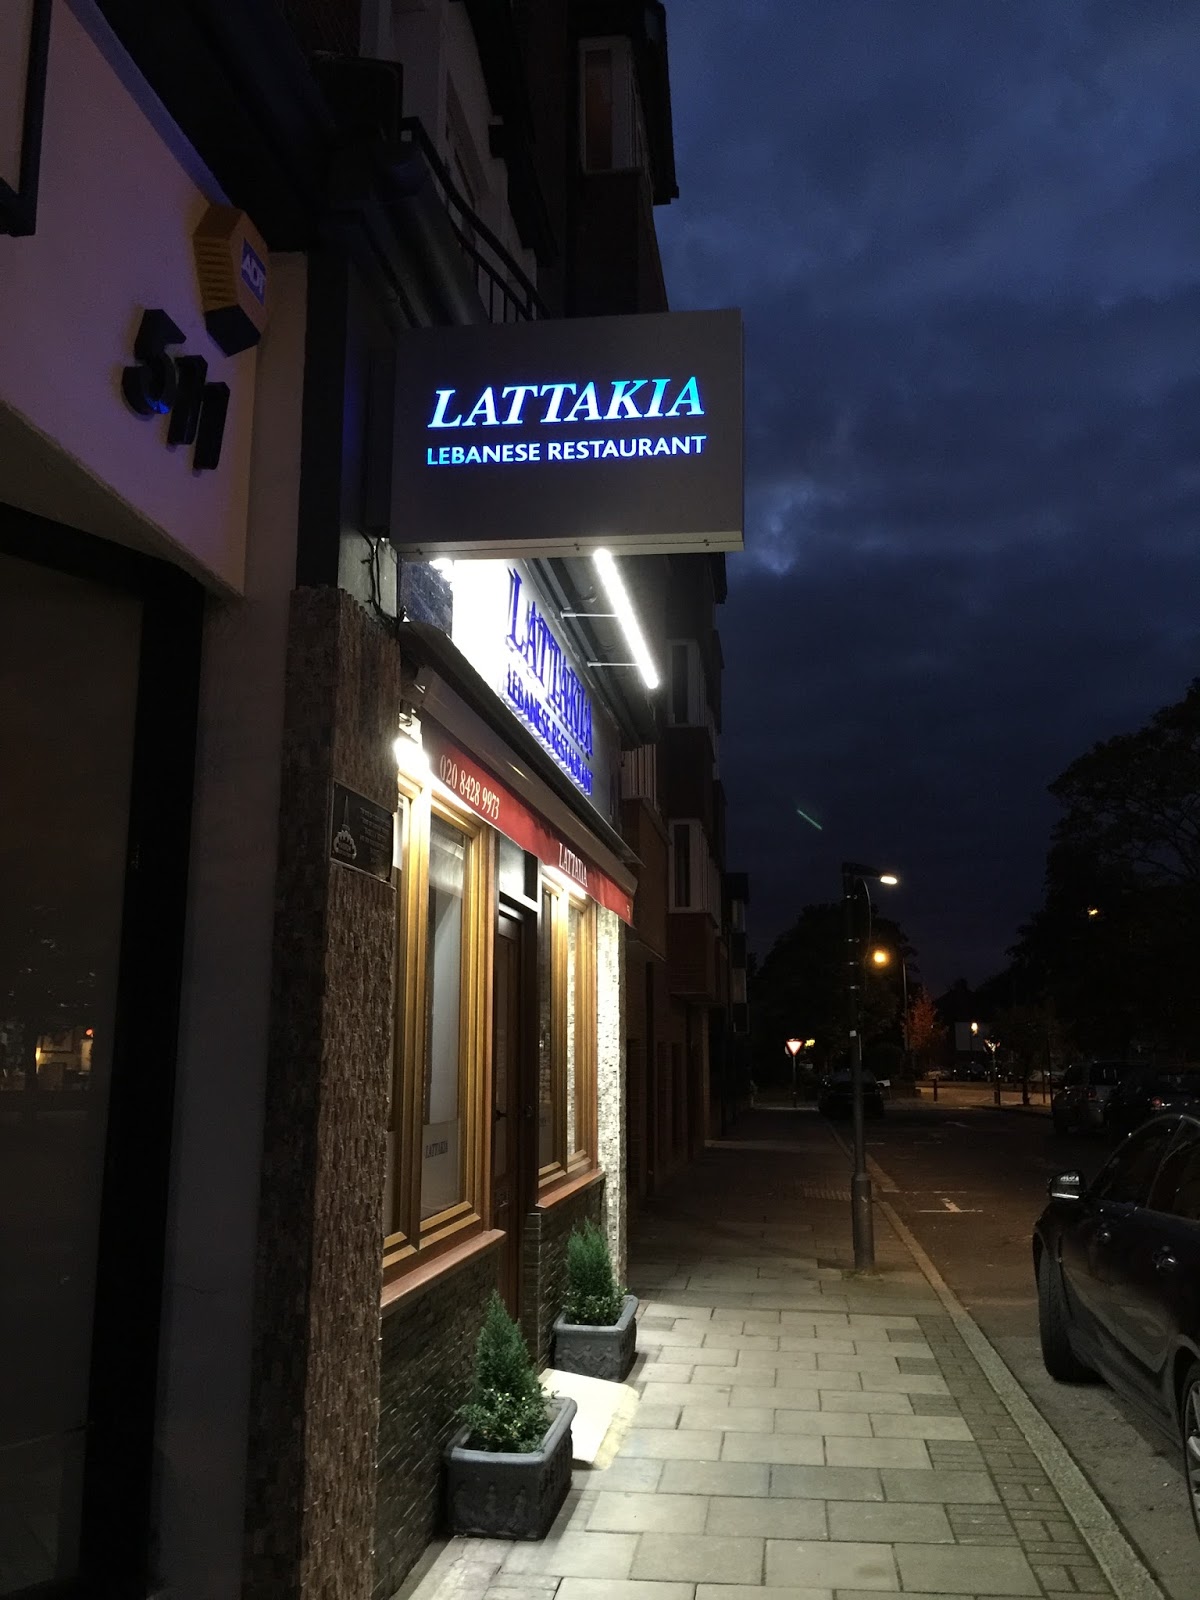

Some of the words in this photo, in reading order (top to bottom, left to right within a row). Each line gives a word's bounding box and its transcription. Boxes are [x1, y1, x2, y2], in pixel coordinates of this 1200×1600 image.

[241, 253, 265, 295] ADT
[427, 376, 705, 429] LATTAKIA
[427, 443, 541, 466] LEBANESE
[547, 435, 707, 462] RESTAURANT
[507, 567, 594, 757] LATTAKIA
[507, 670, 551, 746] LEBANESE
[440, 754, 458, 790] 020
[460, 769, 481, 806] 8428
[481, 786, 500, 820] 9973
